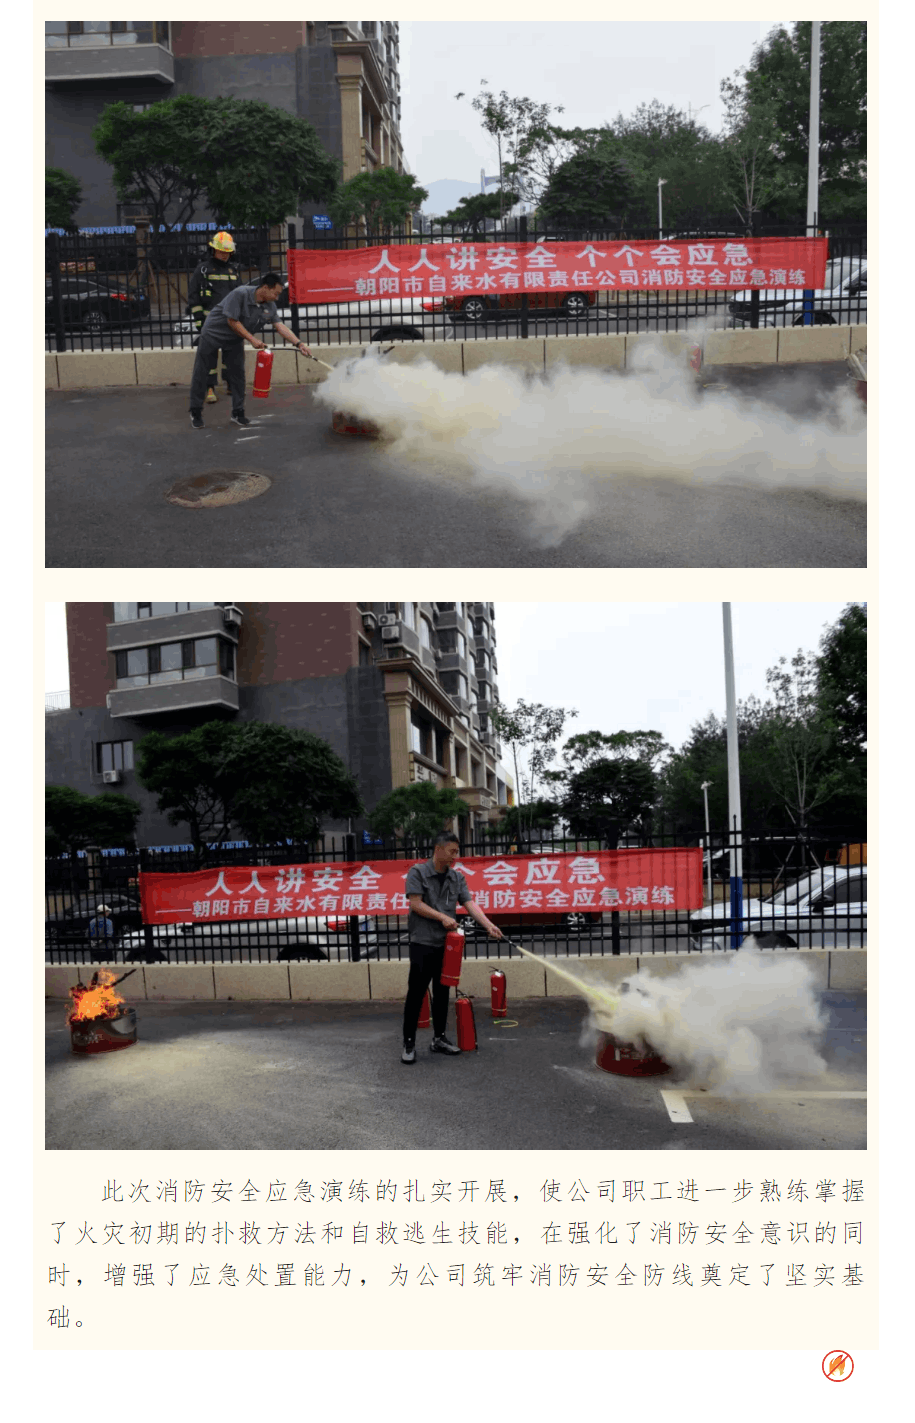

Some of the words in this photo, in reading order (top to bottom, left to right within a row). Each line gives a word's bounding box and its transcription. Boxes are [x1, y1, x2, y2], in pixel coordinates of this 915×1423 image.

[368, 245, 558, 274] 人人讲安全
[575, 242, 754, 268] 个个会应急
[205, 865, 383, 897] 人人讲安全
[401, 856, 606, 886] 会应急
[156, 885, 676, 918] ——朝阳市自来水有限责任消防安全应急演练
[101, 1178, 864, 1204] 此次消防安全应急演练的扎实开展，使公司职工进一步熟练掌握
[51, 1220, 862, 1246] 了火灾初期的扑救方法和自救逃生技能，在强化了消防安全意识的同
[48, 1262, 864, 1288] 时，增强了应急处置能力，为公司筑牢消防安全防线奠定了坚实基
[47, 1304, 83, 1329] 础。
